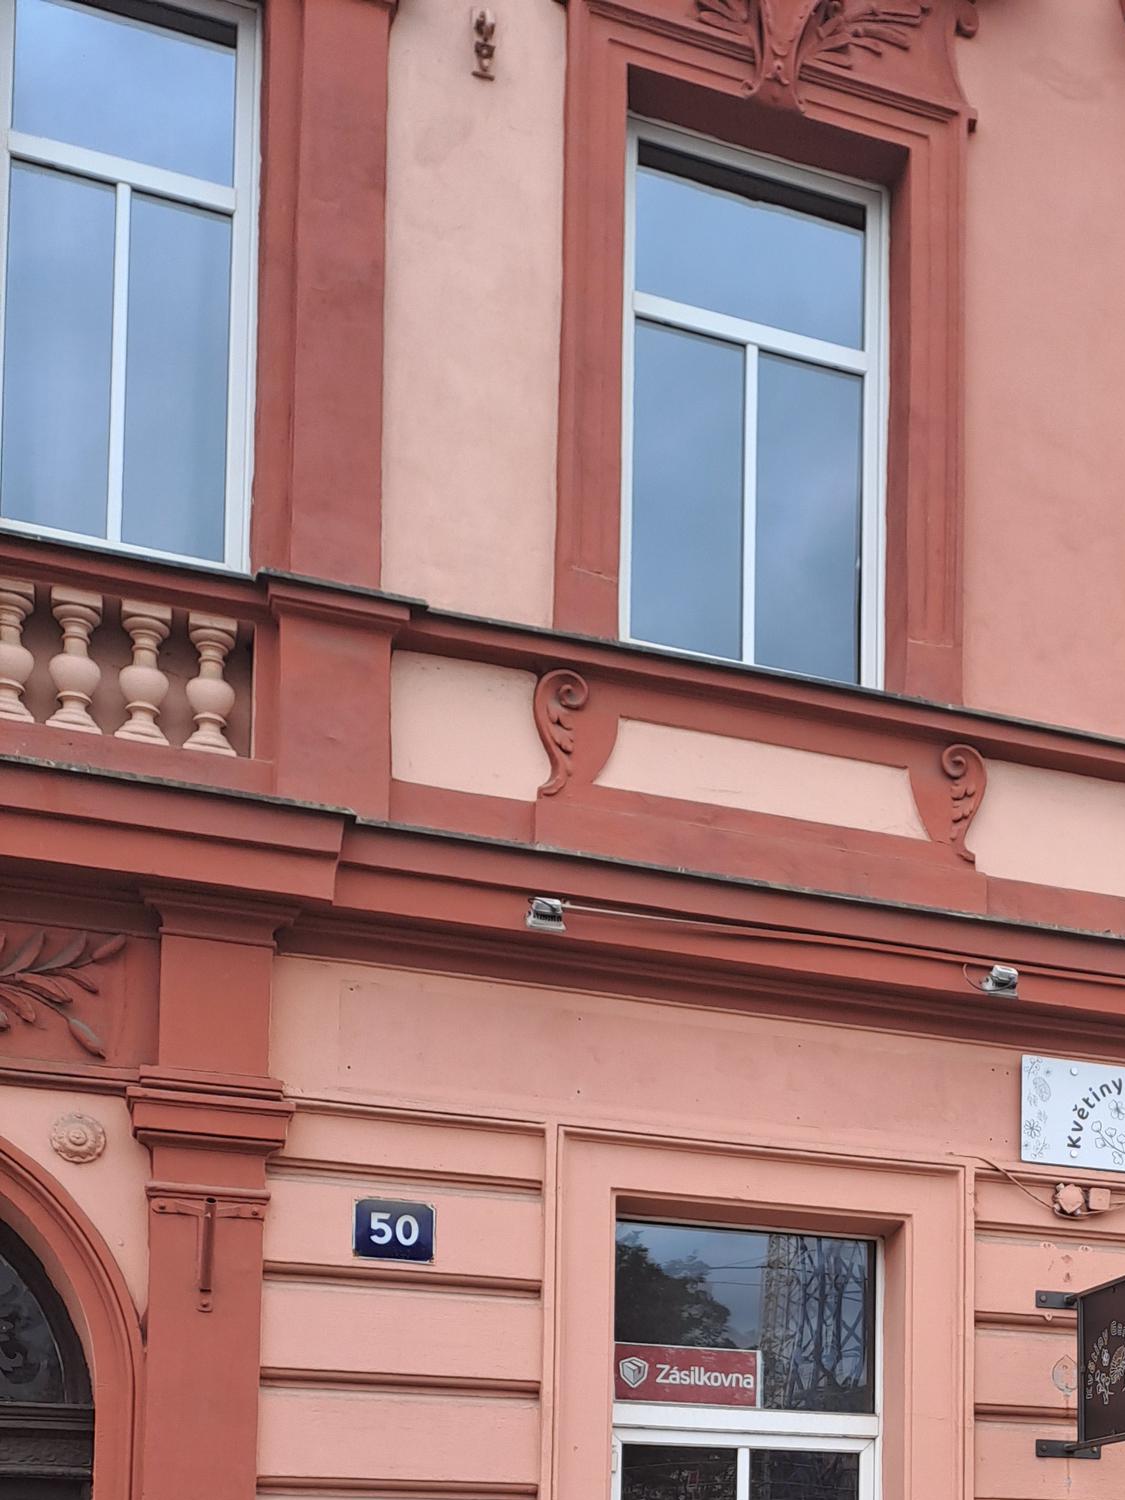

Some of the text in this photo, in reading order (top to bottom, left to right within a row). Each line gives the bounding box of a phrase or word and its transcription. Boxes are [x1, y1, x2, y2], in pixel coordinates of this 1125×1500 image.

[1066, 1077, 1123, 1150] Květiny
[369, 1211, 420, 1247] 50
[655, 1363, 755, 1389] Zásilkovna
